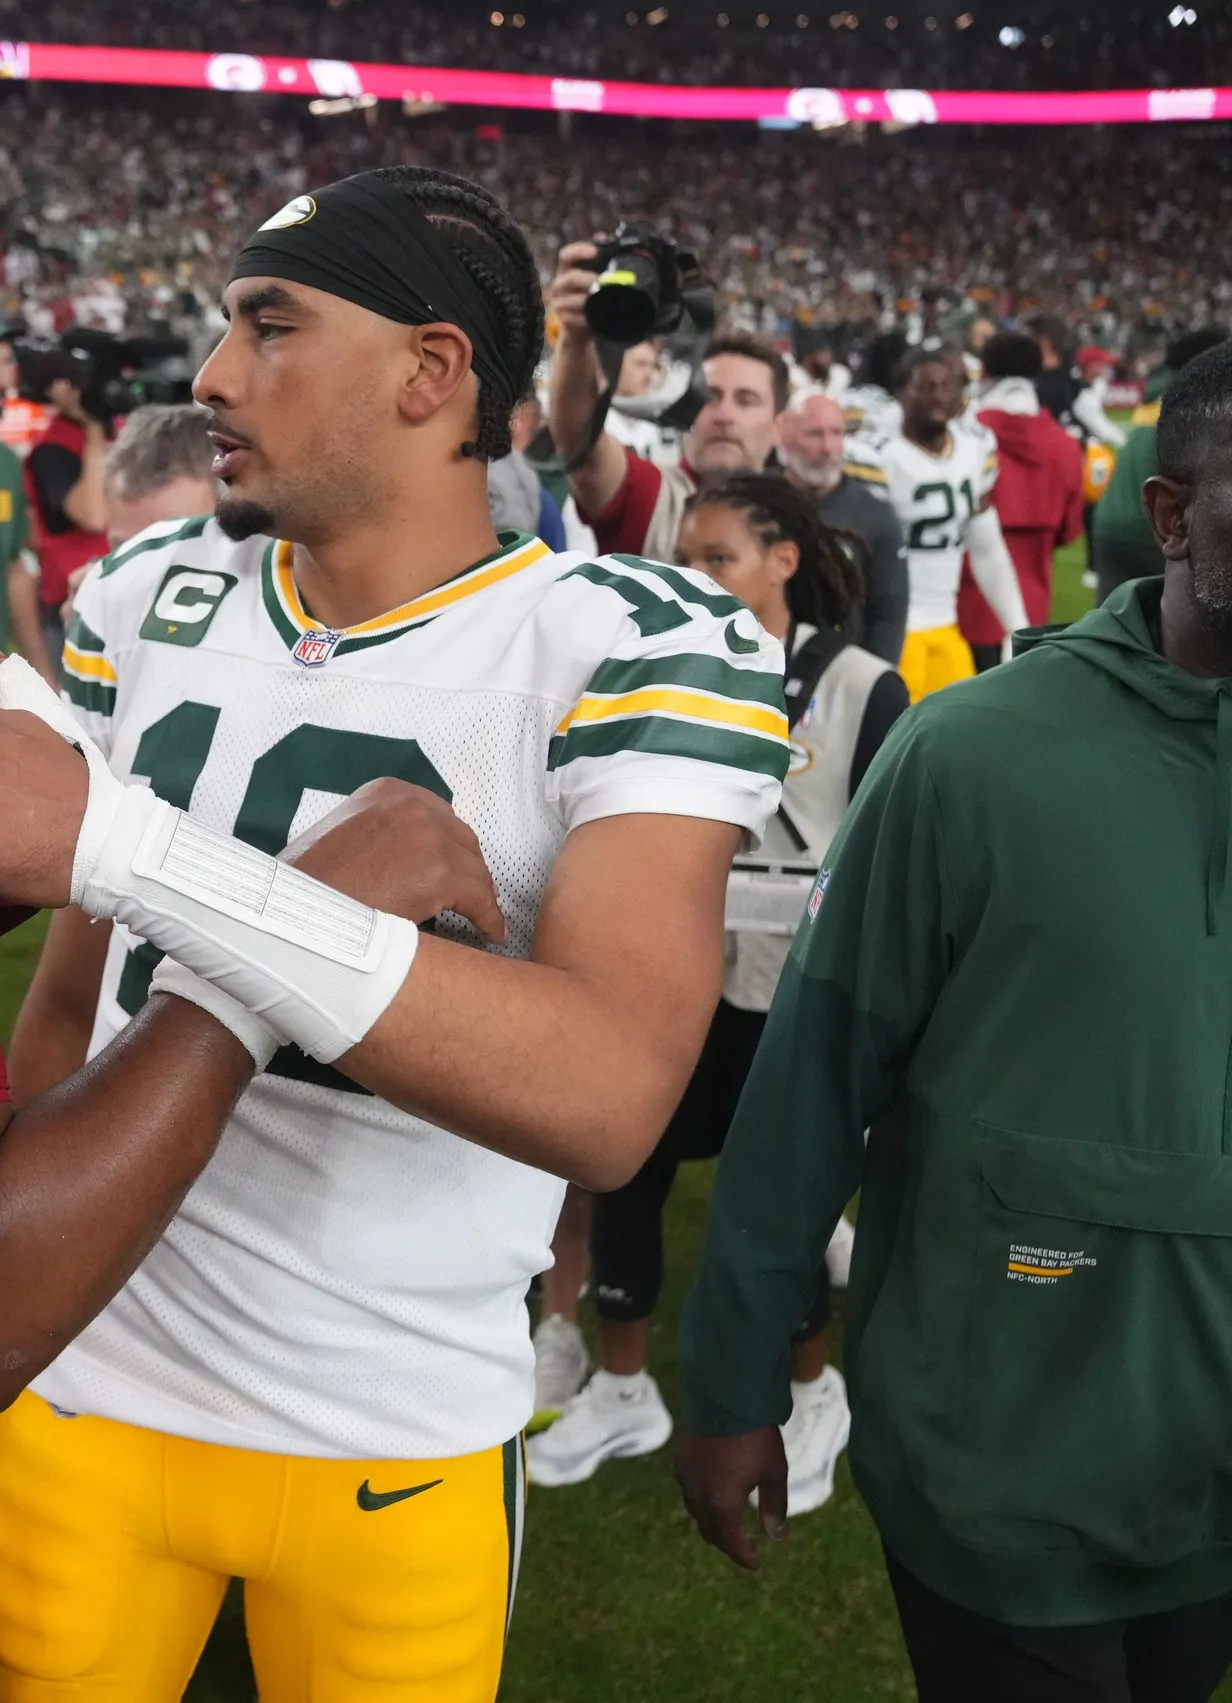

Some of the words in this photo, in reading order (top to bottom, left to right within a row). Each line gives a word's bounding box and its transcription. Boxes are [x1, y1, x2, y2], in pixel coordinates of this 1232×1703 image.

[908, 478, 976, 549] 21
[155, 572, 225, 624] C
[297, 640, 327, 661] NFL
[1008, 1252, 1039, 1266] GREEN
[1040, 1258, 1058, 1268] BAY
[1059, 1257, 1097, 1269] PACKERS
[1009, 1244, 1067, 1260] ENGINEERED
[1068, 1250, 1085, 1260] FOR
[1007, 1271, 1058, 1285] NFC-NORTH
